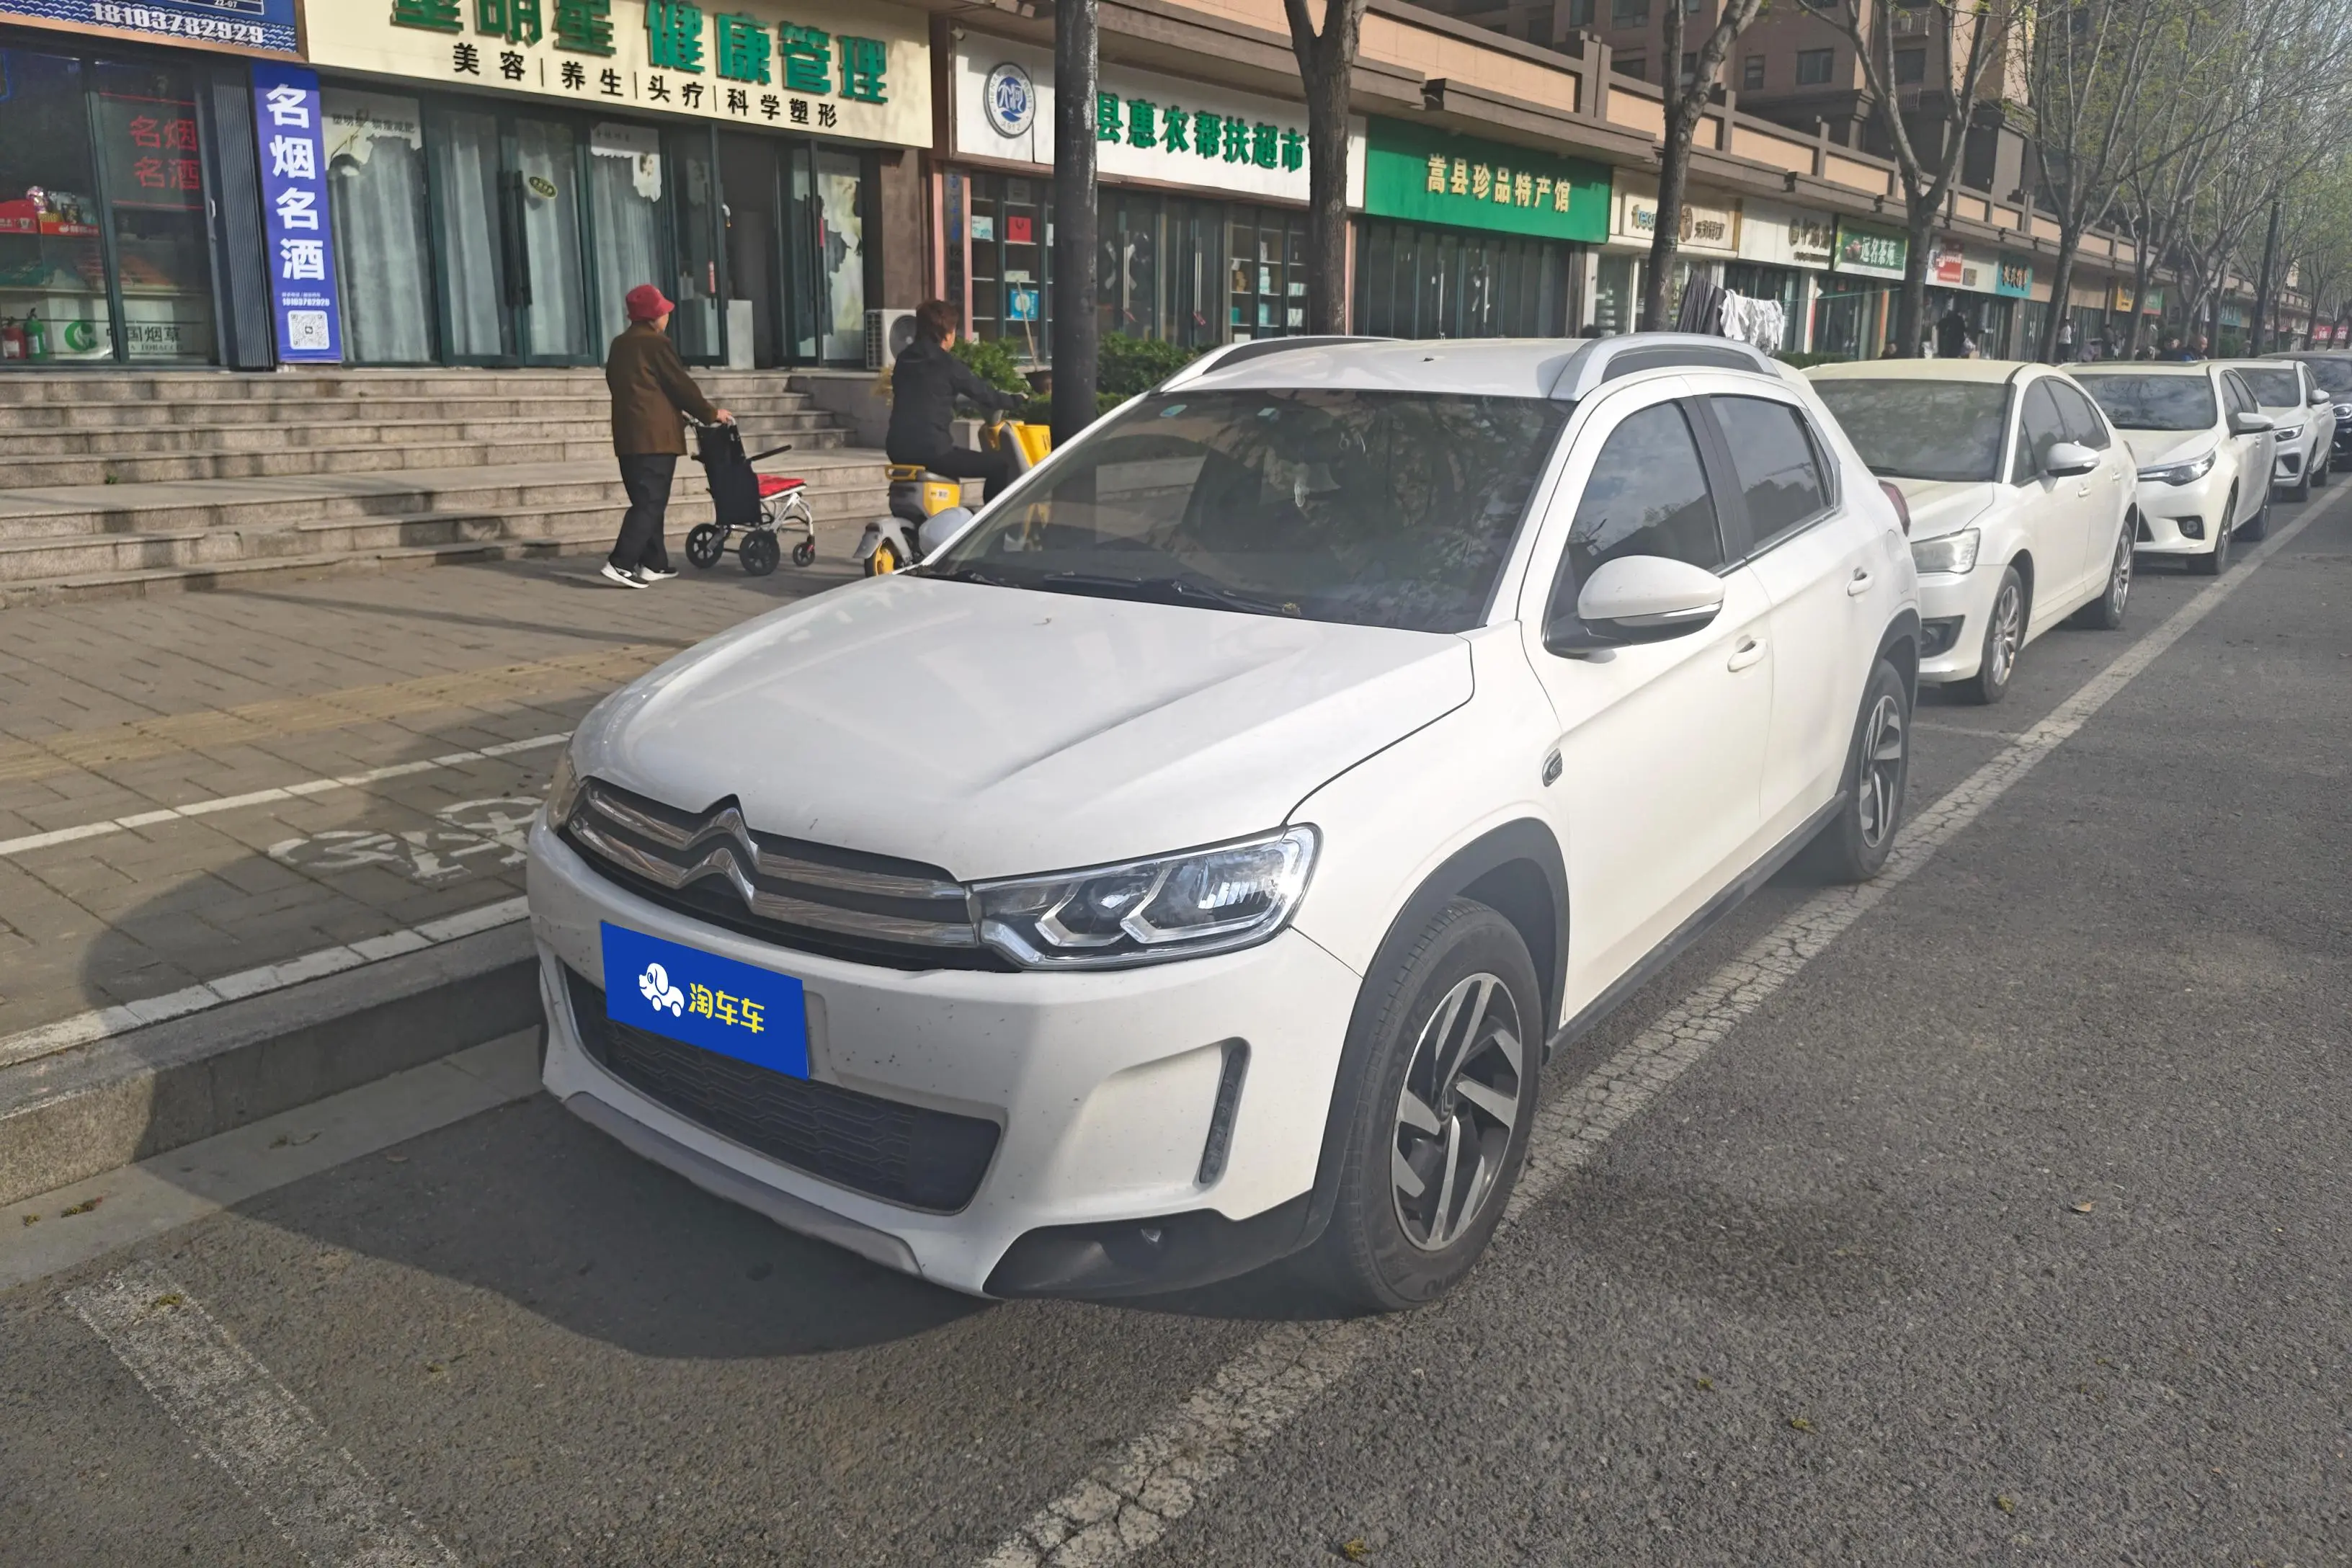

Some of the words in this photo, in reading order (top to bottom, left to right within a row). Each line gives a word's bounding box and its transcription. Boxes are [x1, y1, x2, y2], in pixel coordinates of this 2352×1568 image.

[93, 2, 264, 43] 18103782929
[643, 0, 888, 104] 健康管理
[453, 43, 525, 81] 美容
[561, 61, 623, 97] 养生
[648, 76, 704, 109] 头疗
[727, 88, 837, 128] 科学塑形
[130, 115, 197, 151] 名烟
[1097, 91, 1305, 173] 县惠农帮扶超市
[134, 156, 200, 190] 名酒
[266, 83, 326, 281] 名烟名酒
[1426, 153, 1571, 213] 嵩县珍品特产馆
